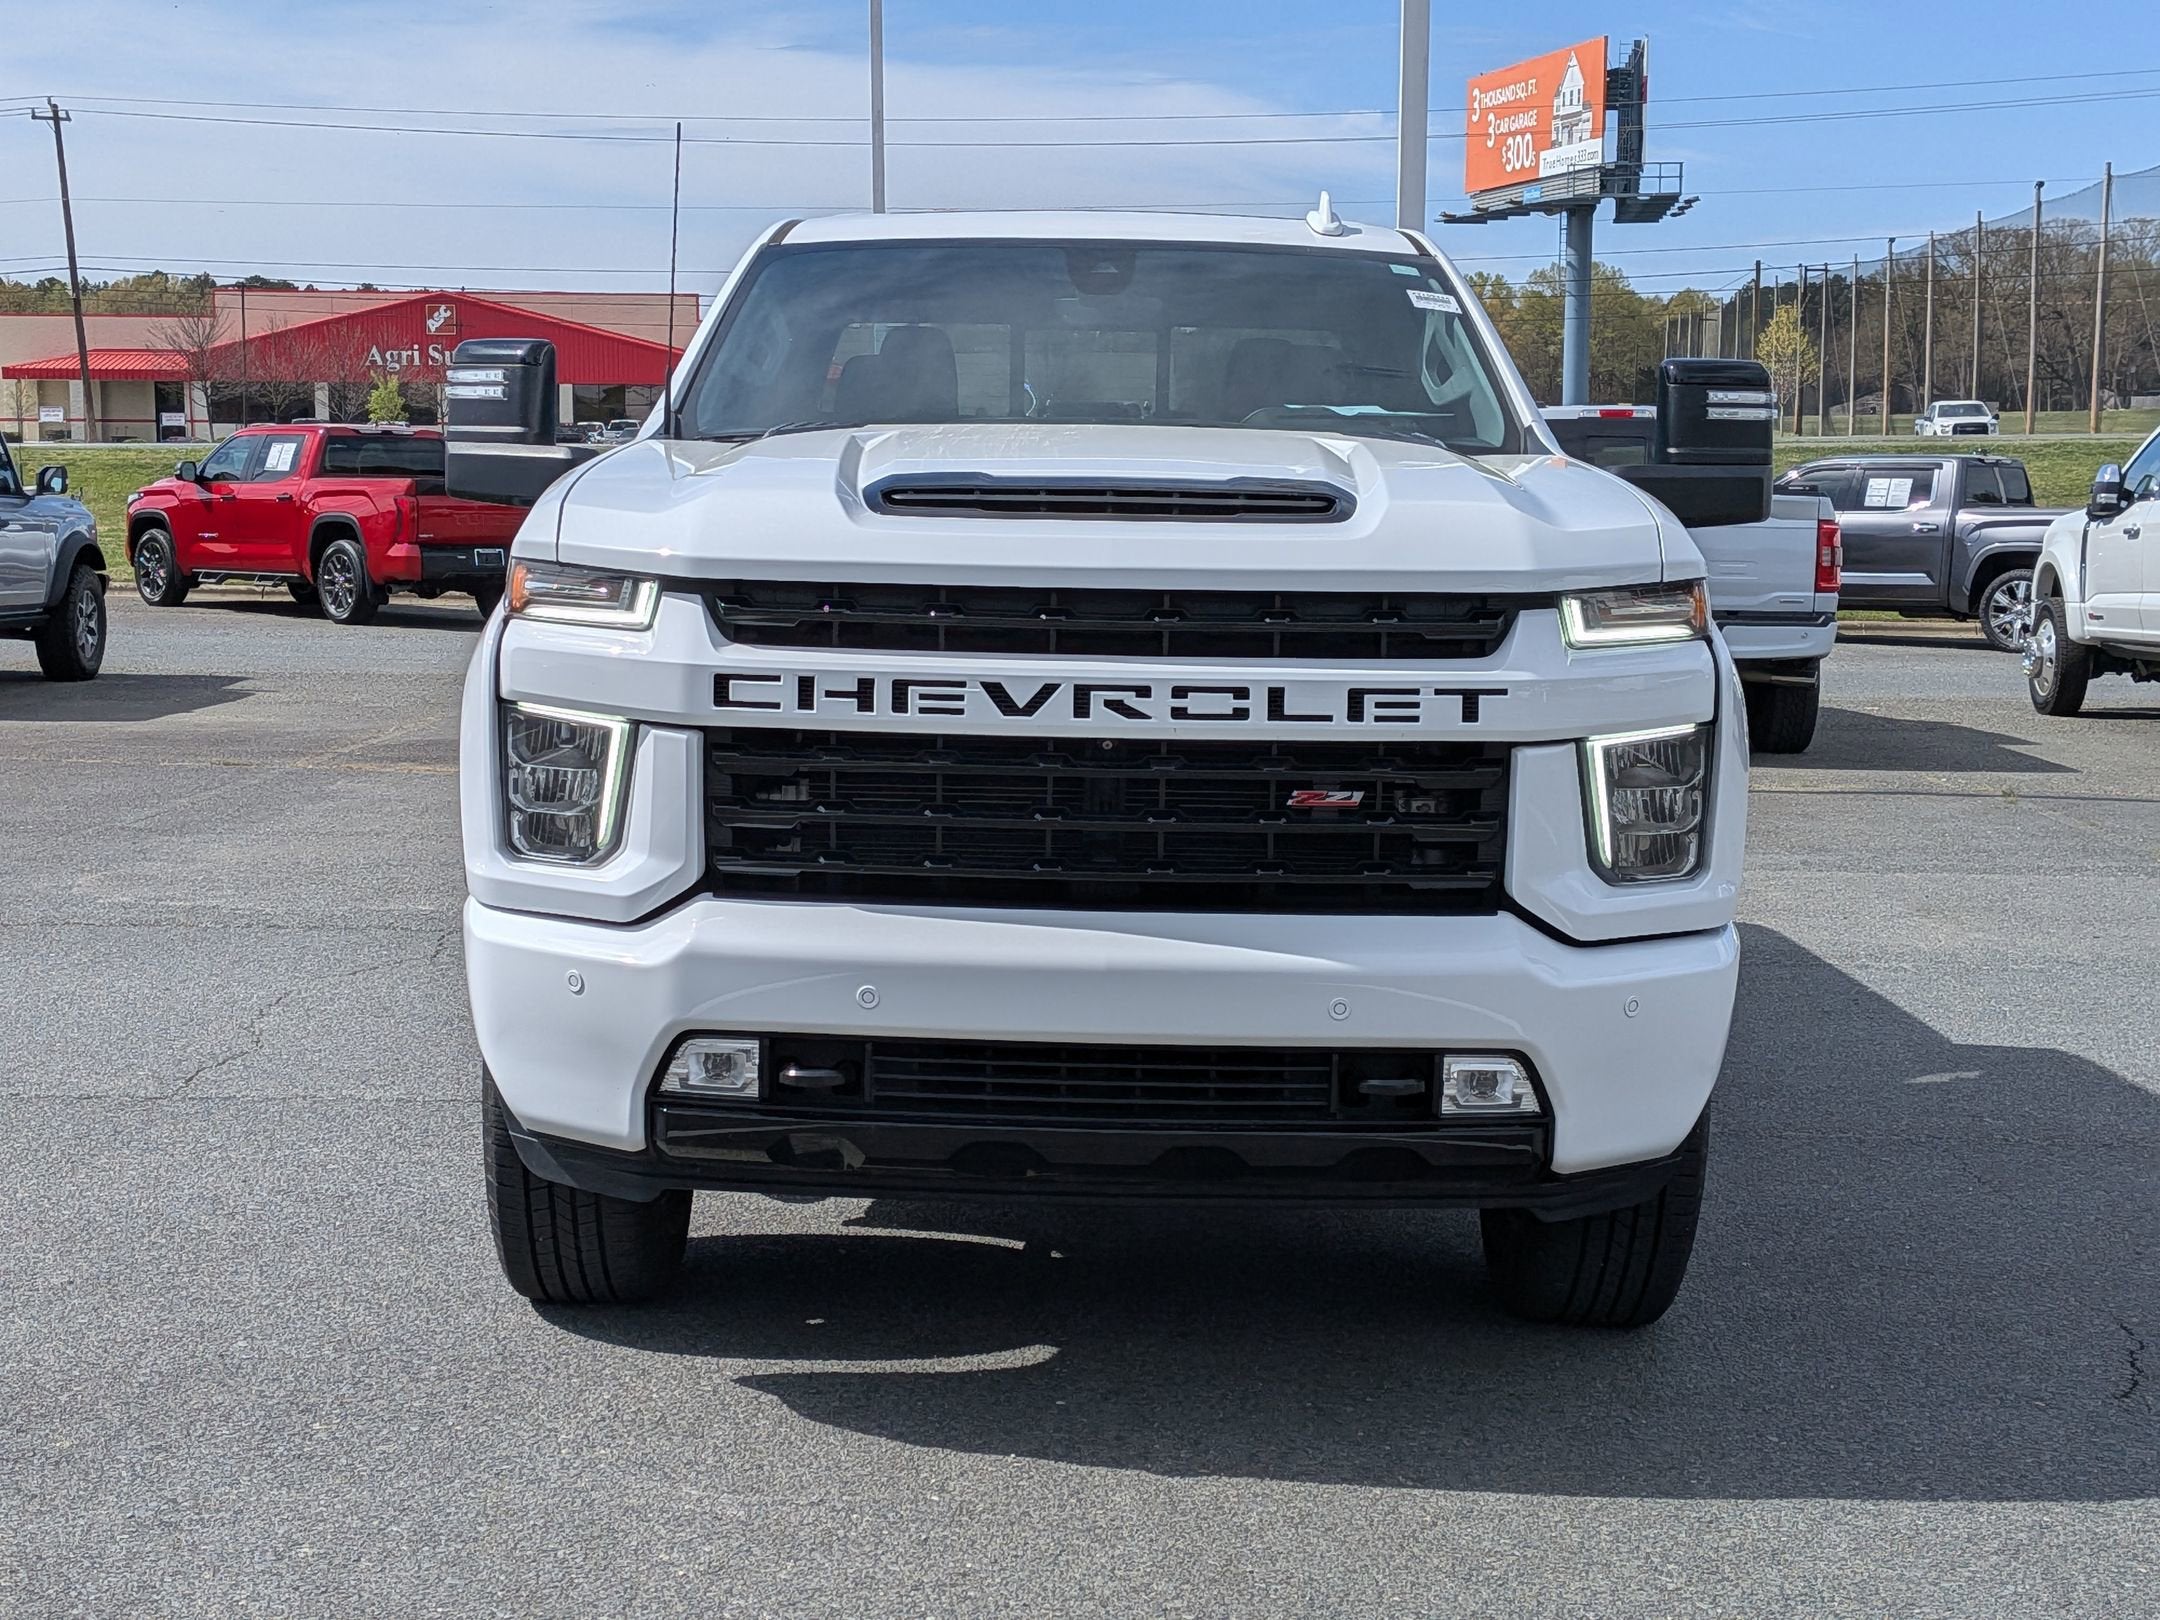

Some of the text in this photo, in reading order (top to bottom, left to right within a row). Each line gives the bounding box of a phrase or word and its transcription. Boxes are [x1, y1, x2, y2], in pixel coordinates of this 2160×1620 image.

[1472, 88, 1480, 123] 3
[1480, 84, 1516, 109] THOUSAND
[1487, 109, 1537, 148] 3 CAR GARAGE
[365, 344, 421, 372] Agri
[712, 672, 1510, 723] CHEVROLET
[1286, 790, 1365, 807] Z71
